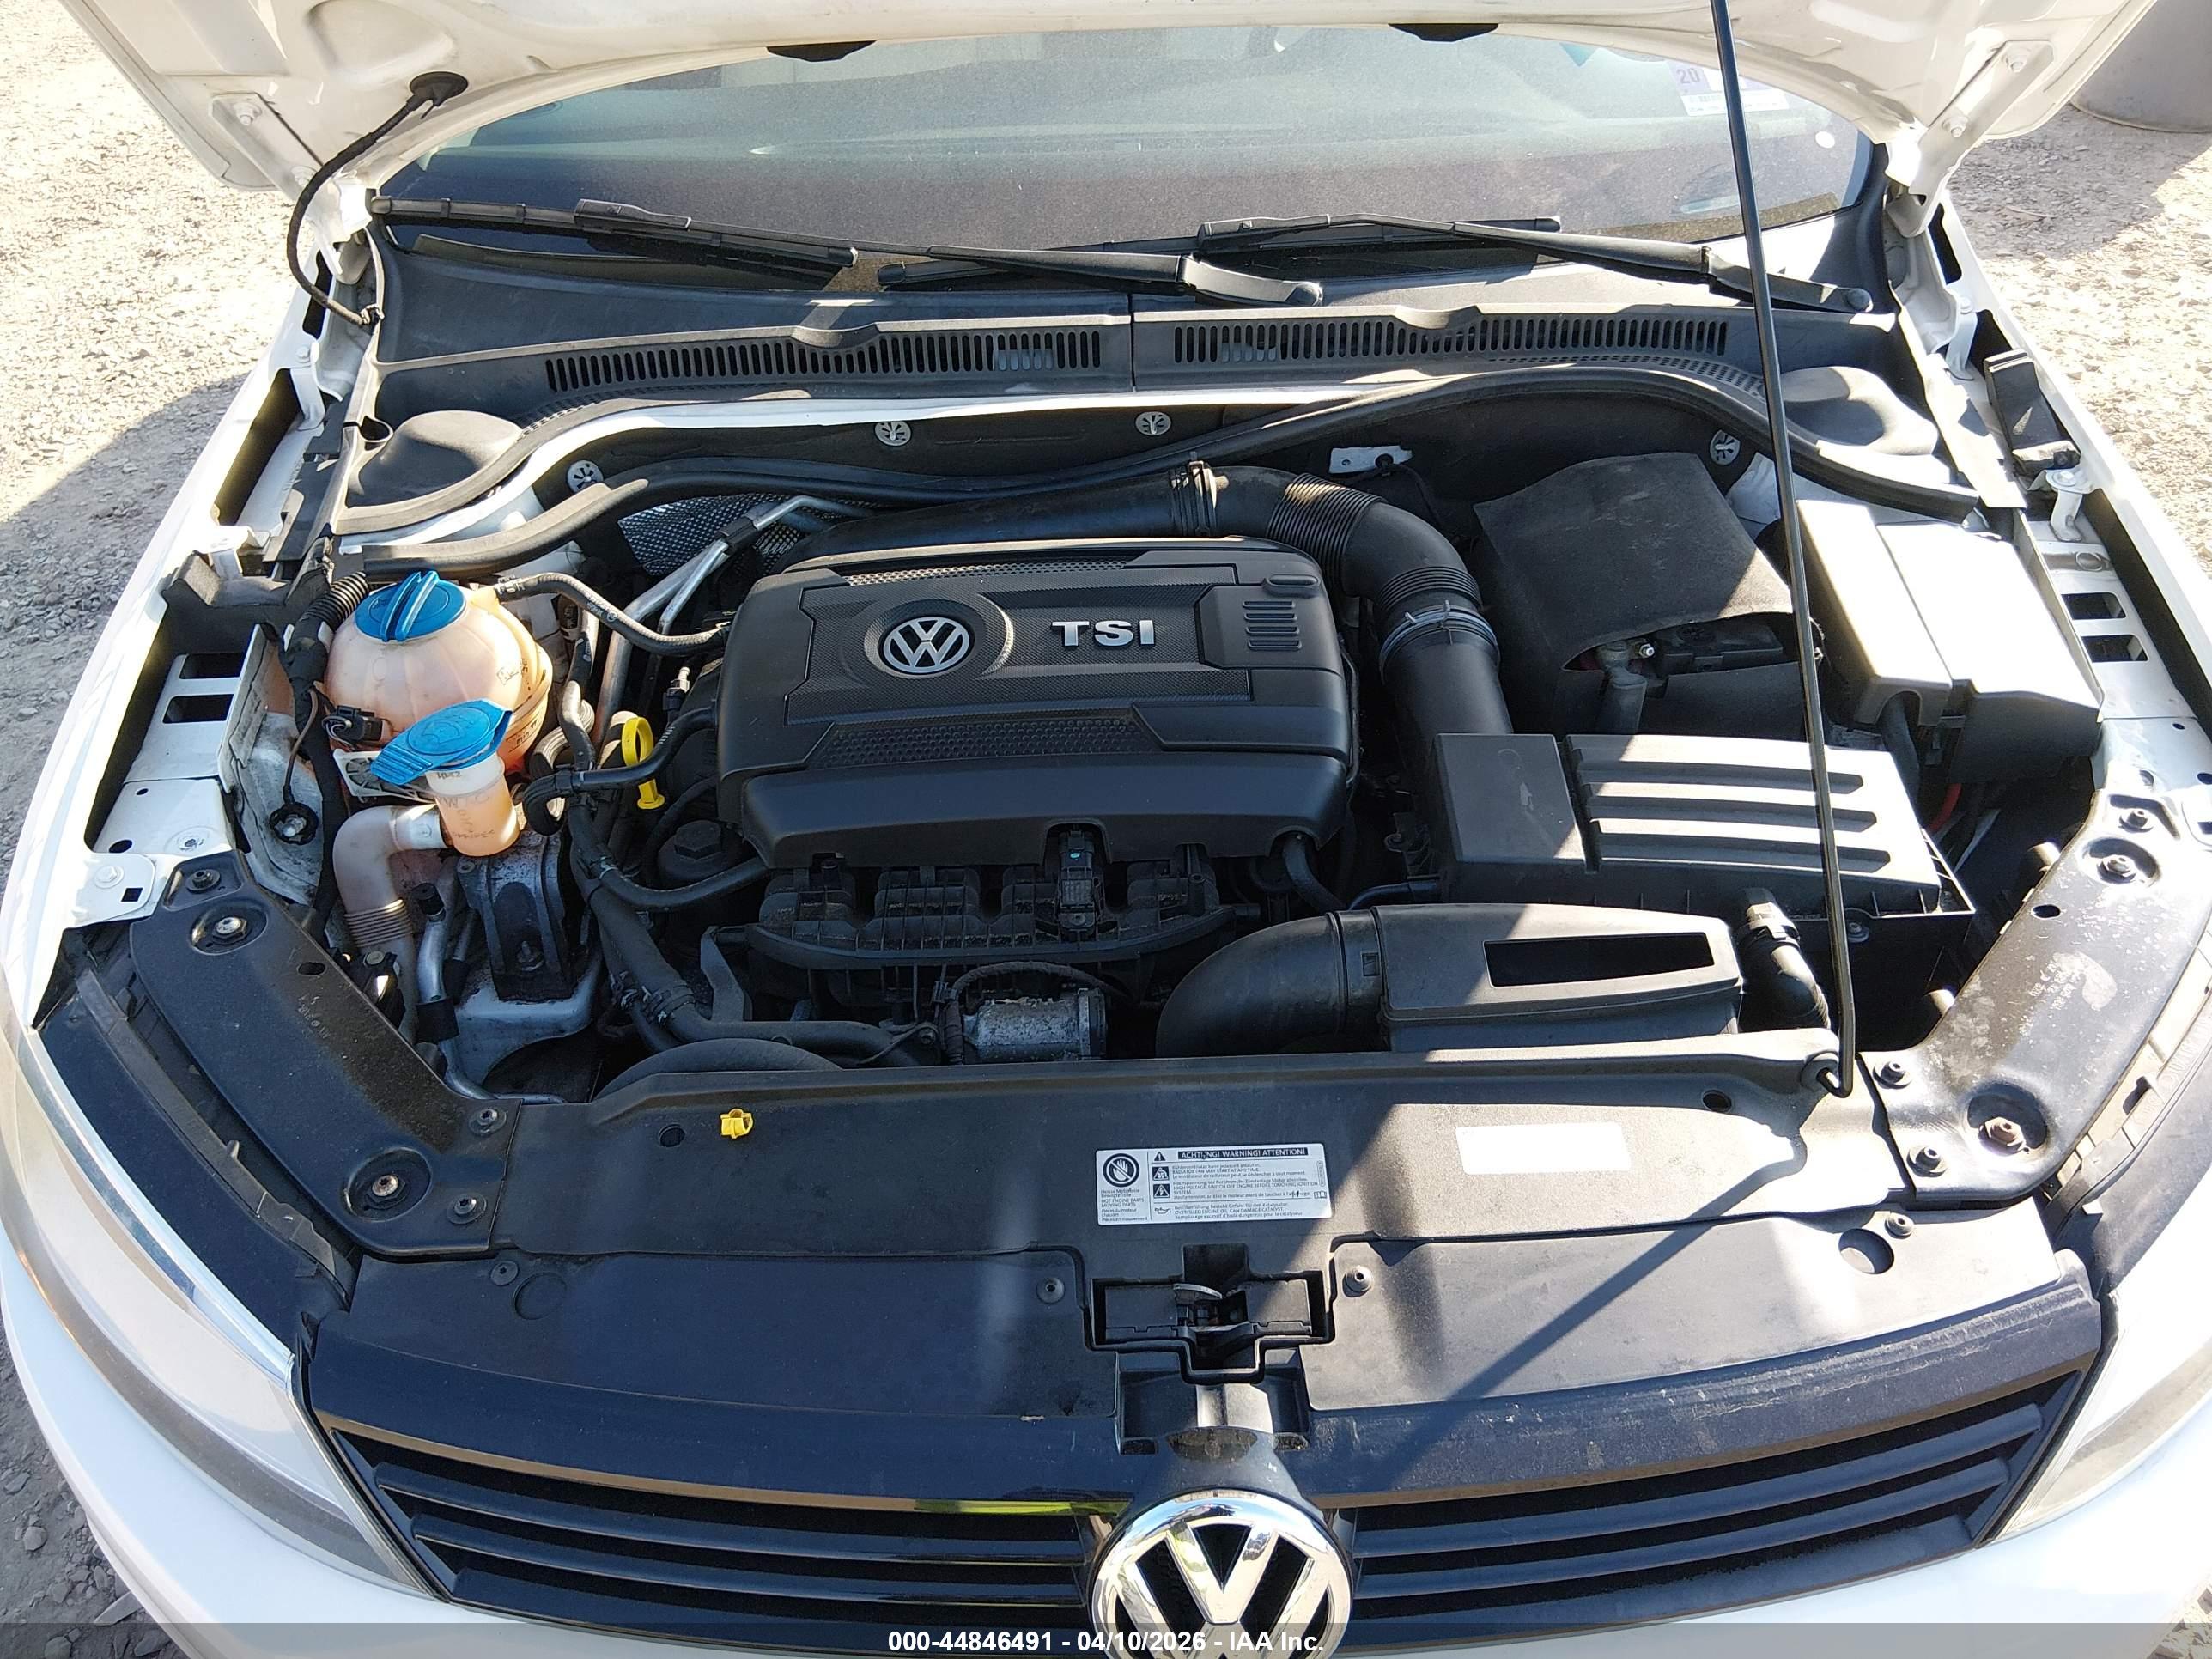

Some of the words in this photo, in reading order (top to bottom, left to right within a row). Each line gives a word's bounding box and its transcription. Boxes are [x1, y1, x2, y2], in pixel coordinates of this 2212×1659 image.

[1051, 619, 1156, 647] TSI
[1222, 1150, 1261, 1158] WARNING!
[1262, 1148, 1306, 1157] ATTENTION!
